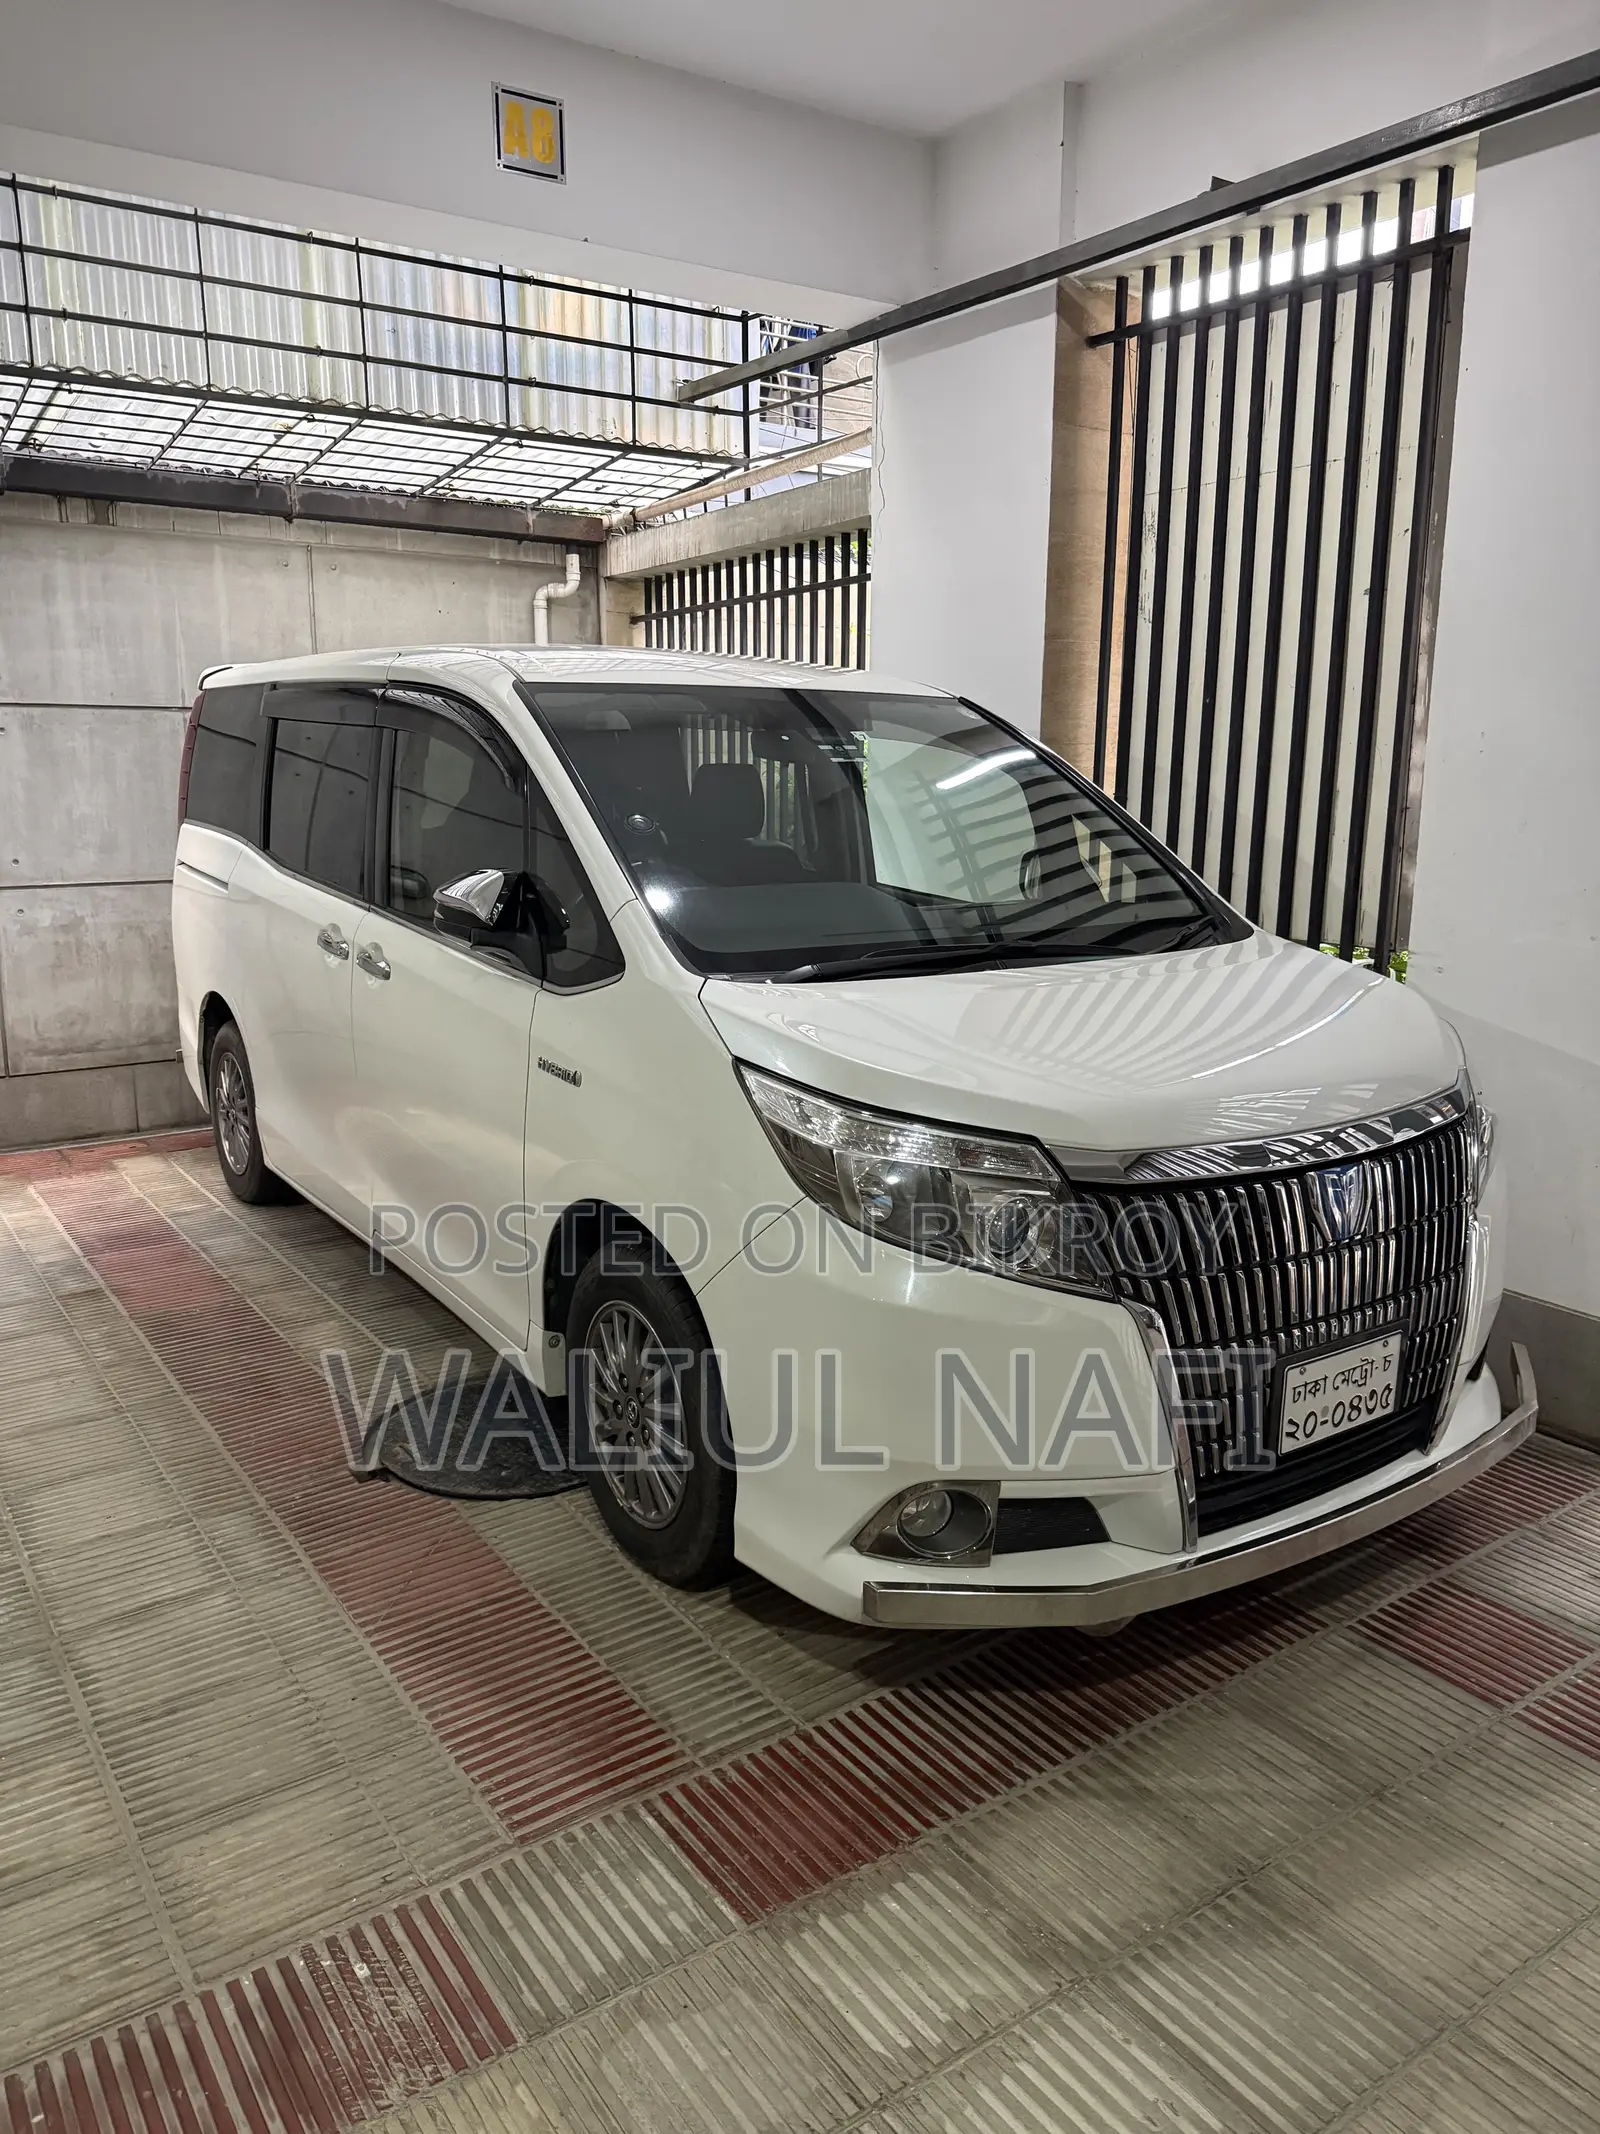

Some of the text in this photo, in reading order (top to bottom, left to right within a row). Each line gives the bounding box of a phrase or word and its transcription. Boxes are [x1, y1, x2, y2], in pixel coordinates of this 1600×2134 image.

[503, 101, 555, 164] A8
[537, 1056, 577, 1086] HYBRID
[1292, 1374, 1329, 1404] ঢাকা
[1285, 1382, 1393, 1441] ২০-০৪৩৫
